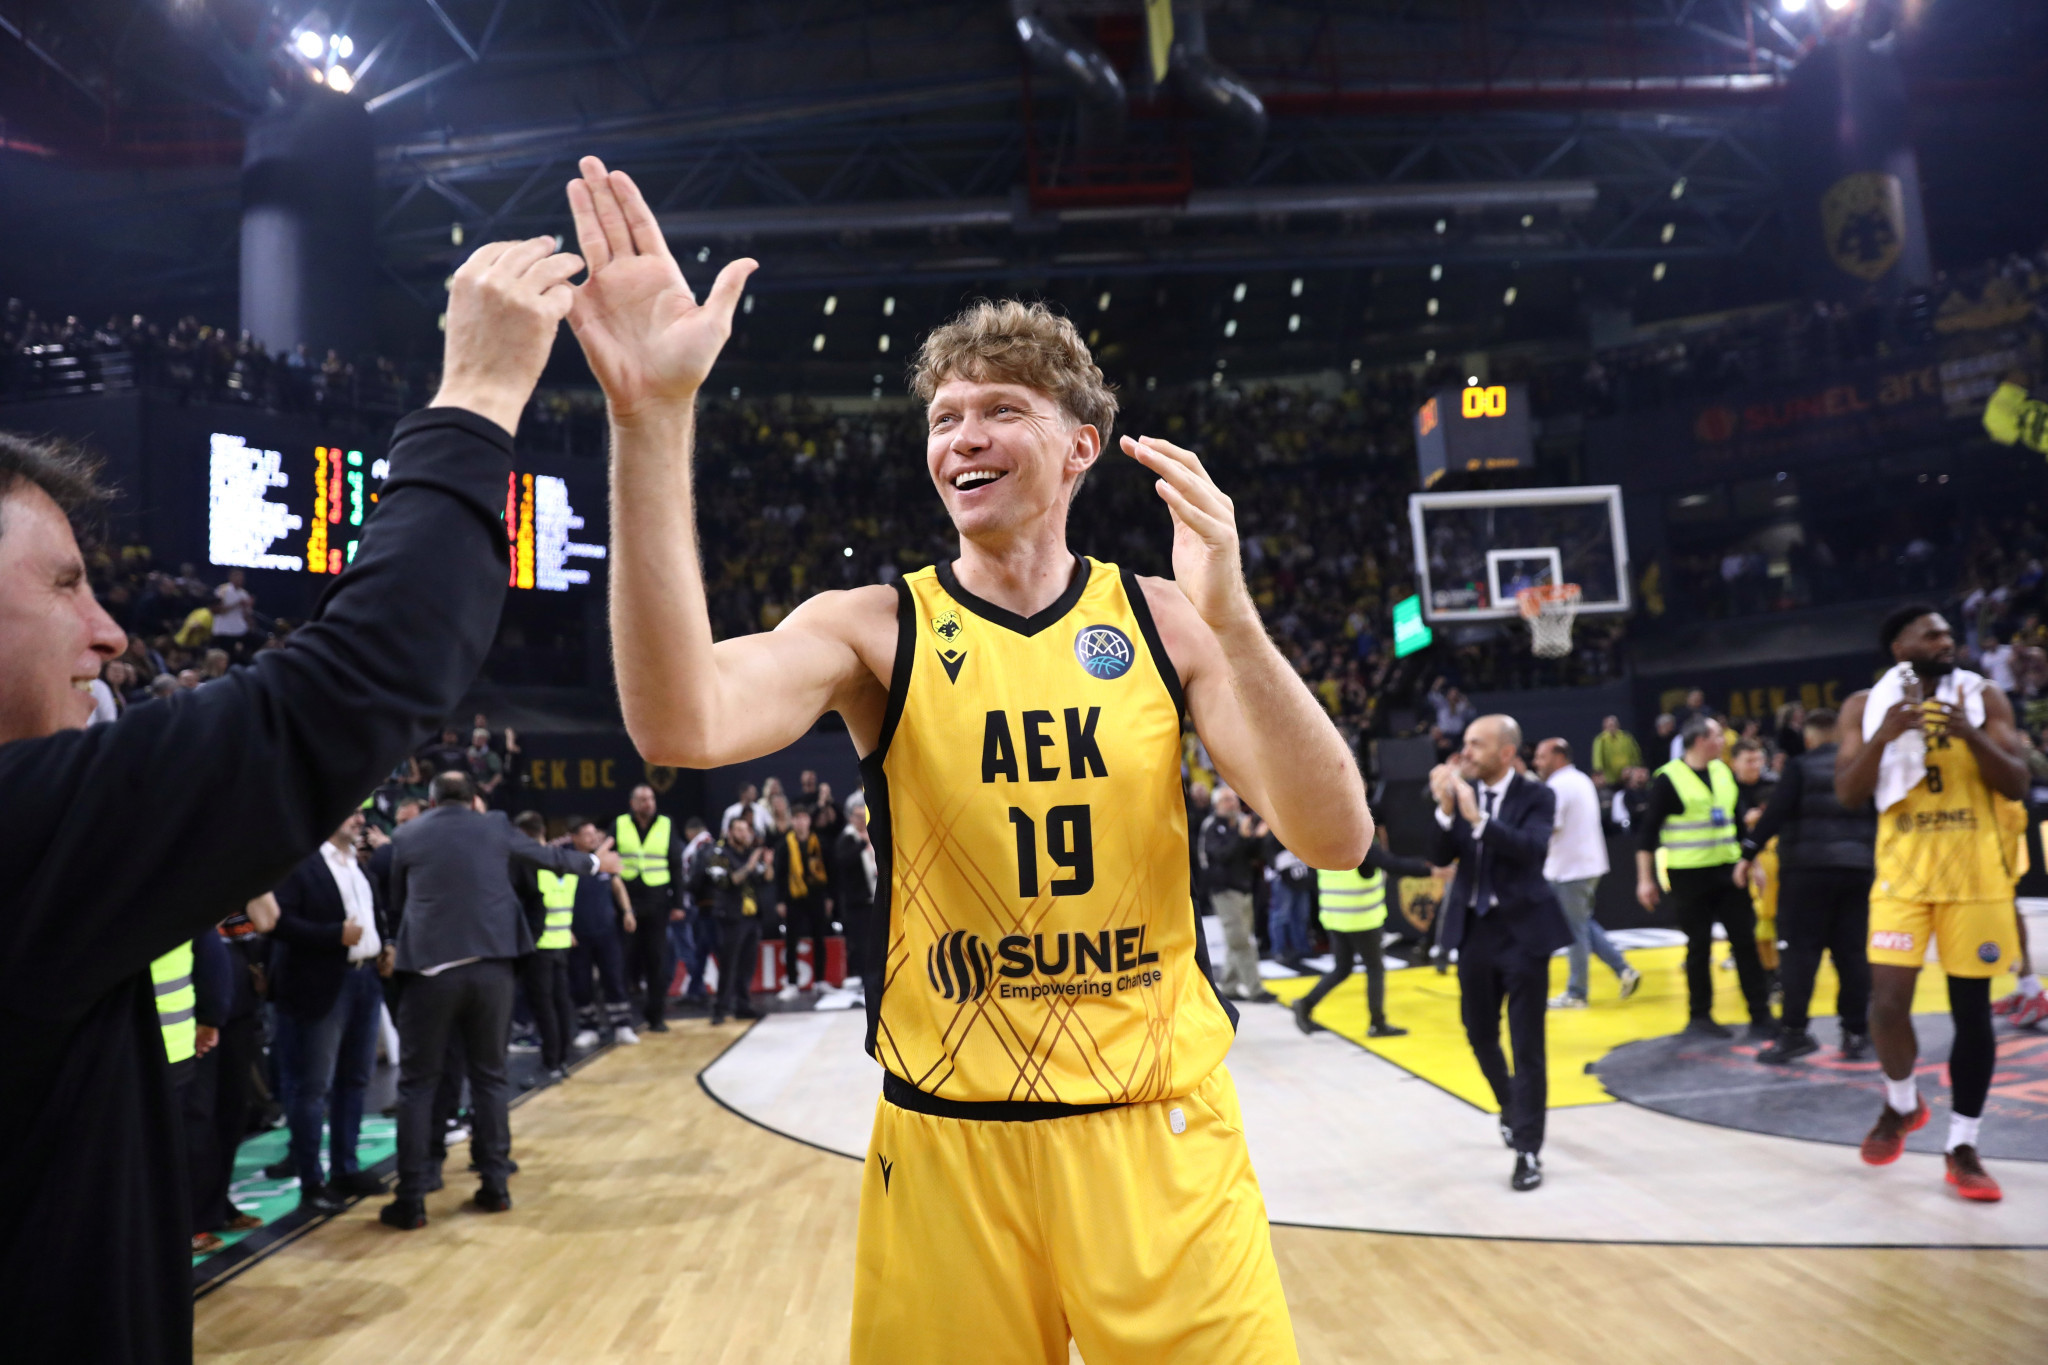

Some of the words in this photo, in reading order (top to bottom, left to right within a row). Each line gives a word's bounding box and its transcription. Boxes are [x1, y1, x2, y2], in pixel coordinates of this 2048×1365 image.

[981, 706, 1109, 784] AEK
[531, 758, 568, 790] EK
[1008, 804, 1095, 899] 19
[998, 924, 1159, 978] SUNEL
[1000, 979, 1112, 1001] Empowering
[1116, 970, 1162, 992] Change
